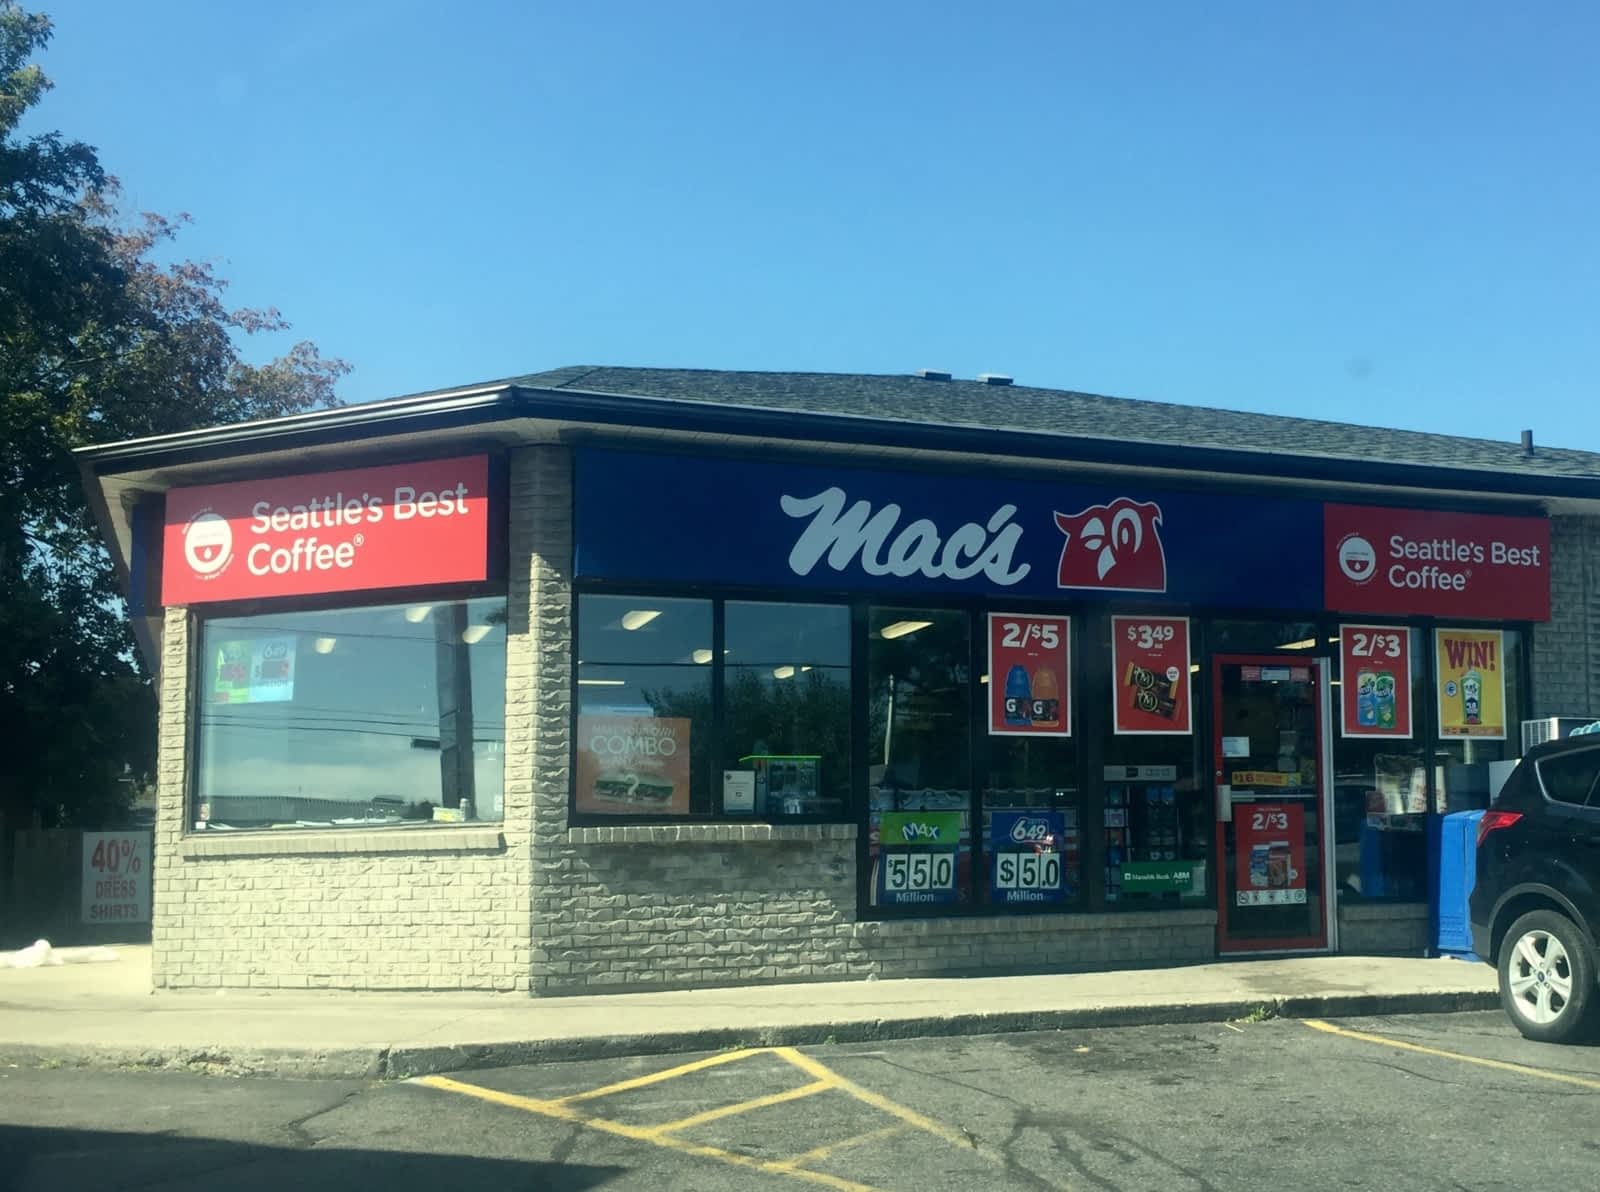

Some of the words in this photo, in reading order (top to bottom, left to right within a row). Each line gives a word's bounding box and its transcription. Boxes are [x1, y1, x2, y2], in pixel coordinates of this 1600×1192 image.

[250, 492, 384, 534] Seattle's
[393, 482, 469, 521] Best
[779, 486, 1032, 586] Mac's
[1389, 535, 1484, 563] Seattle's
[1490, 541, 1541, 567] Best
[1001, 622, 1060, 649] 2/$5
[1351, 633, 1401, 657] 2/$3
[1444, 639, 1496, 671] WIN!
[1006, 698, 1017, 712] G
[1033, 701, 1043, 715] G
[591, 735, 677, 756] COMBO
[902, 822, 941, 841] MAX
[91, 839, 141, 874] 40%
[95, 880, 137, 899] DRESS
[895, 891, 936, 904] Million
[1006, 890, 1044, 903] Million
[89, 903, 139, 921] SHIRTS
